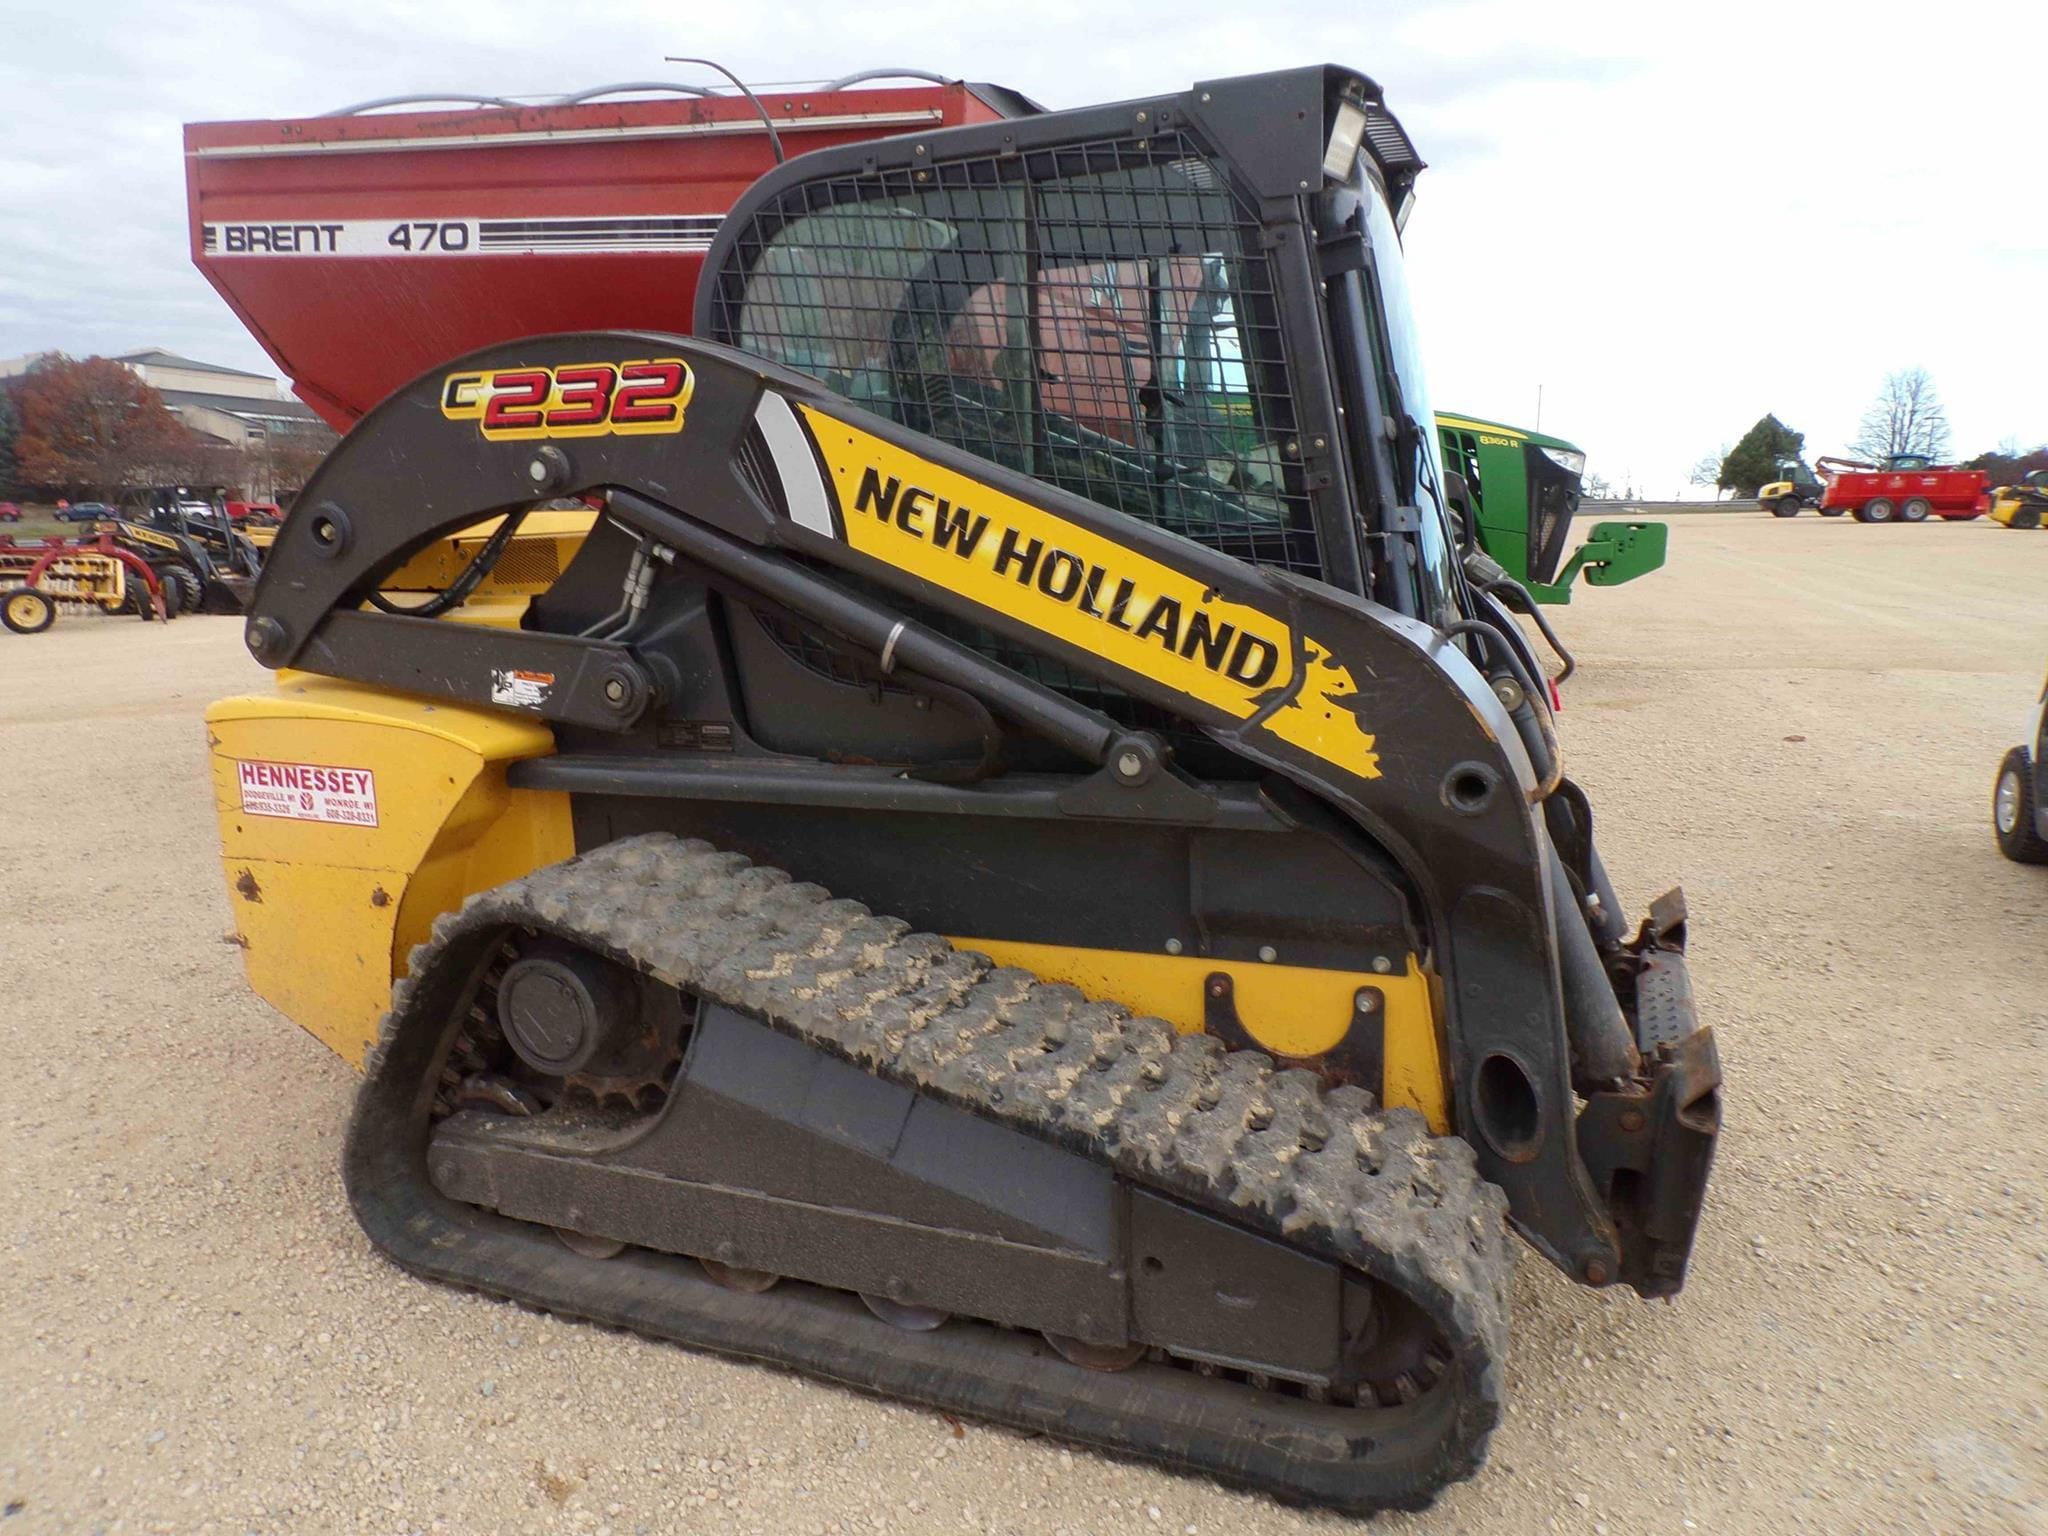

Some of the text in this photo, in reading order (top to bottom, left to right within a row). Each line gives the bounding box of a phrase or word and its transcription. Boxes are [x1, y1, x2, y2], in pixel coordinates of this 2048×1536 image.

[225, 222, 469, 252] BRENT 470
[442, 358, 694, 440] C232
[854, 466, 1279, 689] NEW HOLLAND
[242, 763, 369, 795] HENNESSEY
